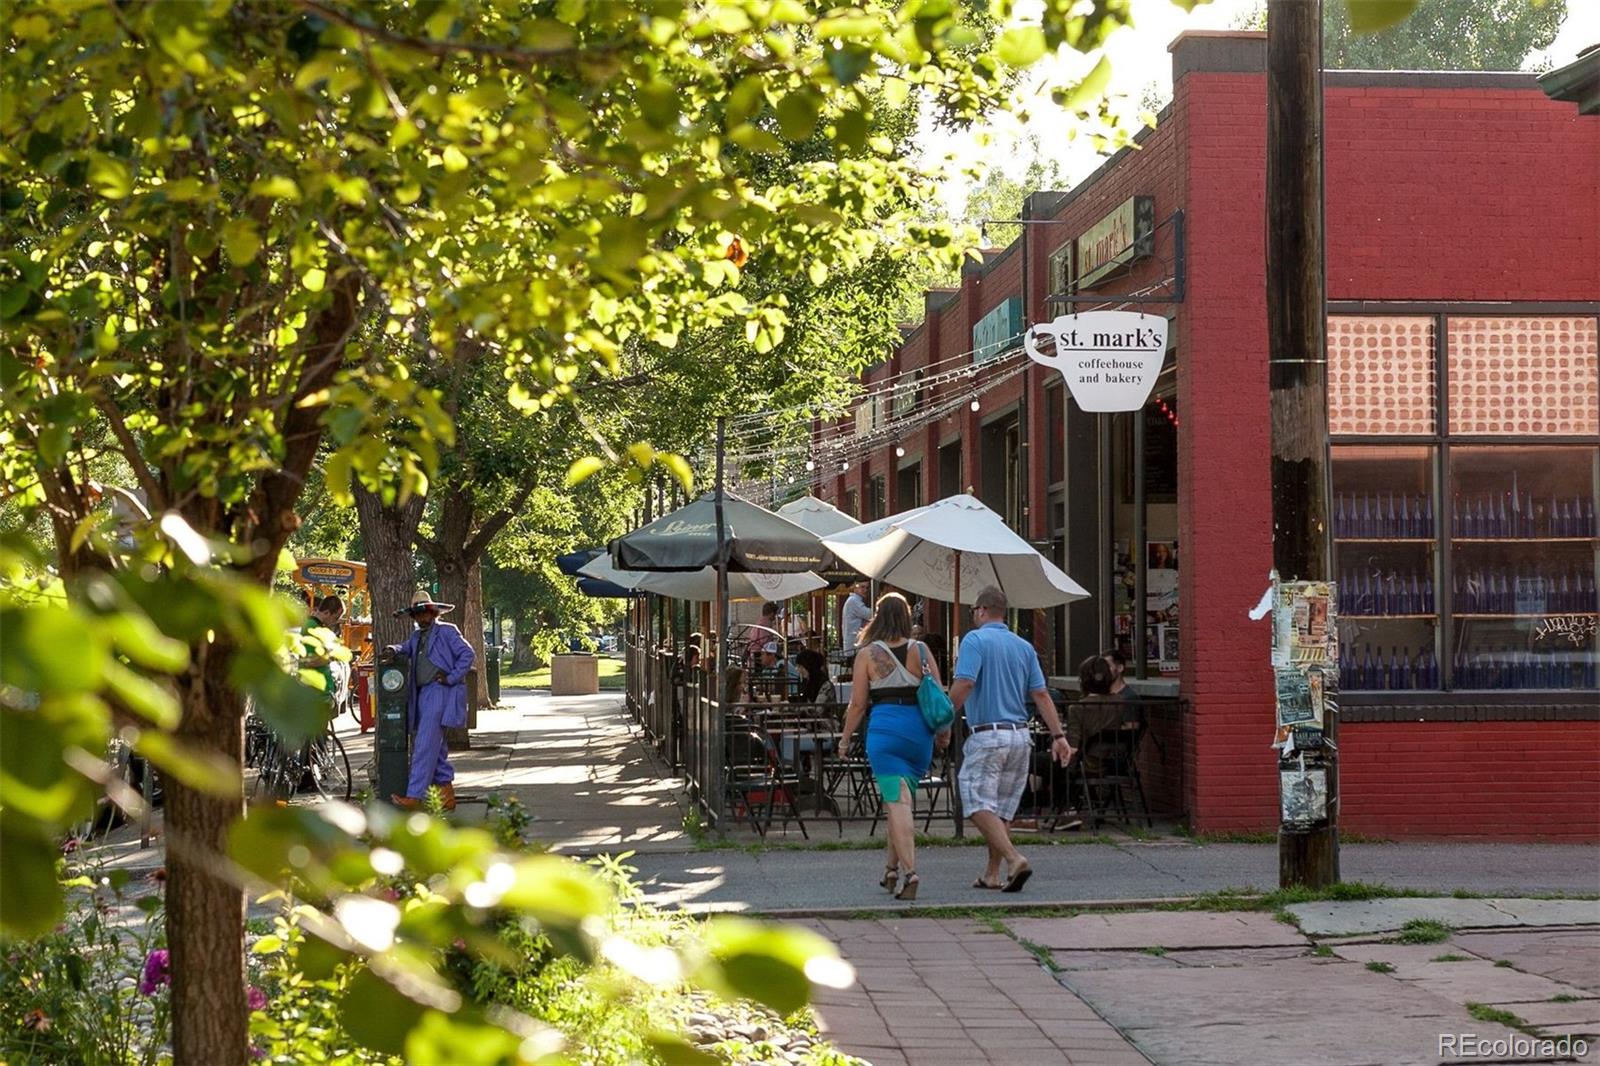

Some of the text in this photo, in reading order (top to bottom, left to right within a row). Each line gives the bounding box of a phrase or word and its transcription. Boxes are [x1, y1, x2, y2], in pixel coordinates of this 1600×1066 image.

[1060, 328, 1162, 347] st. mark's
[1078, 359, 1143, 369] coffeehouse
[1079, 373, 1142, 385] and bakery
